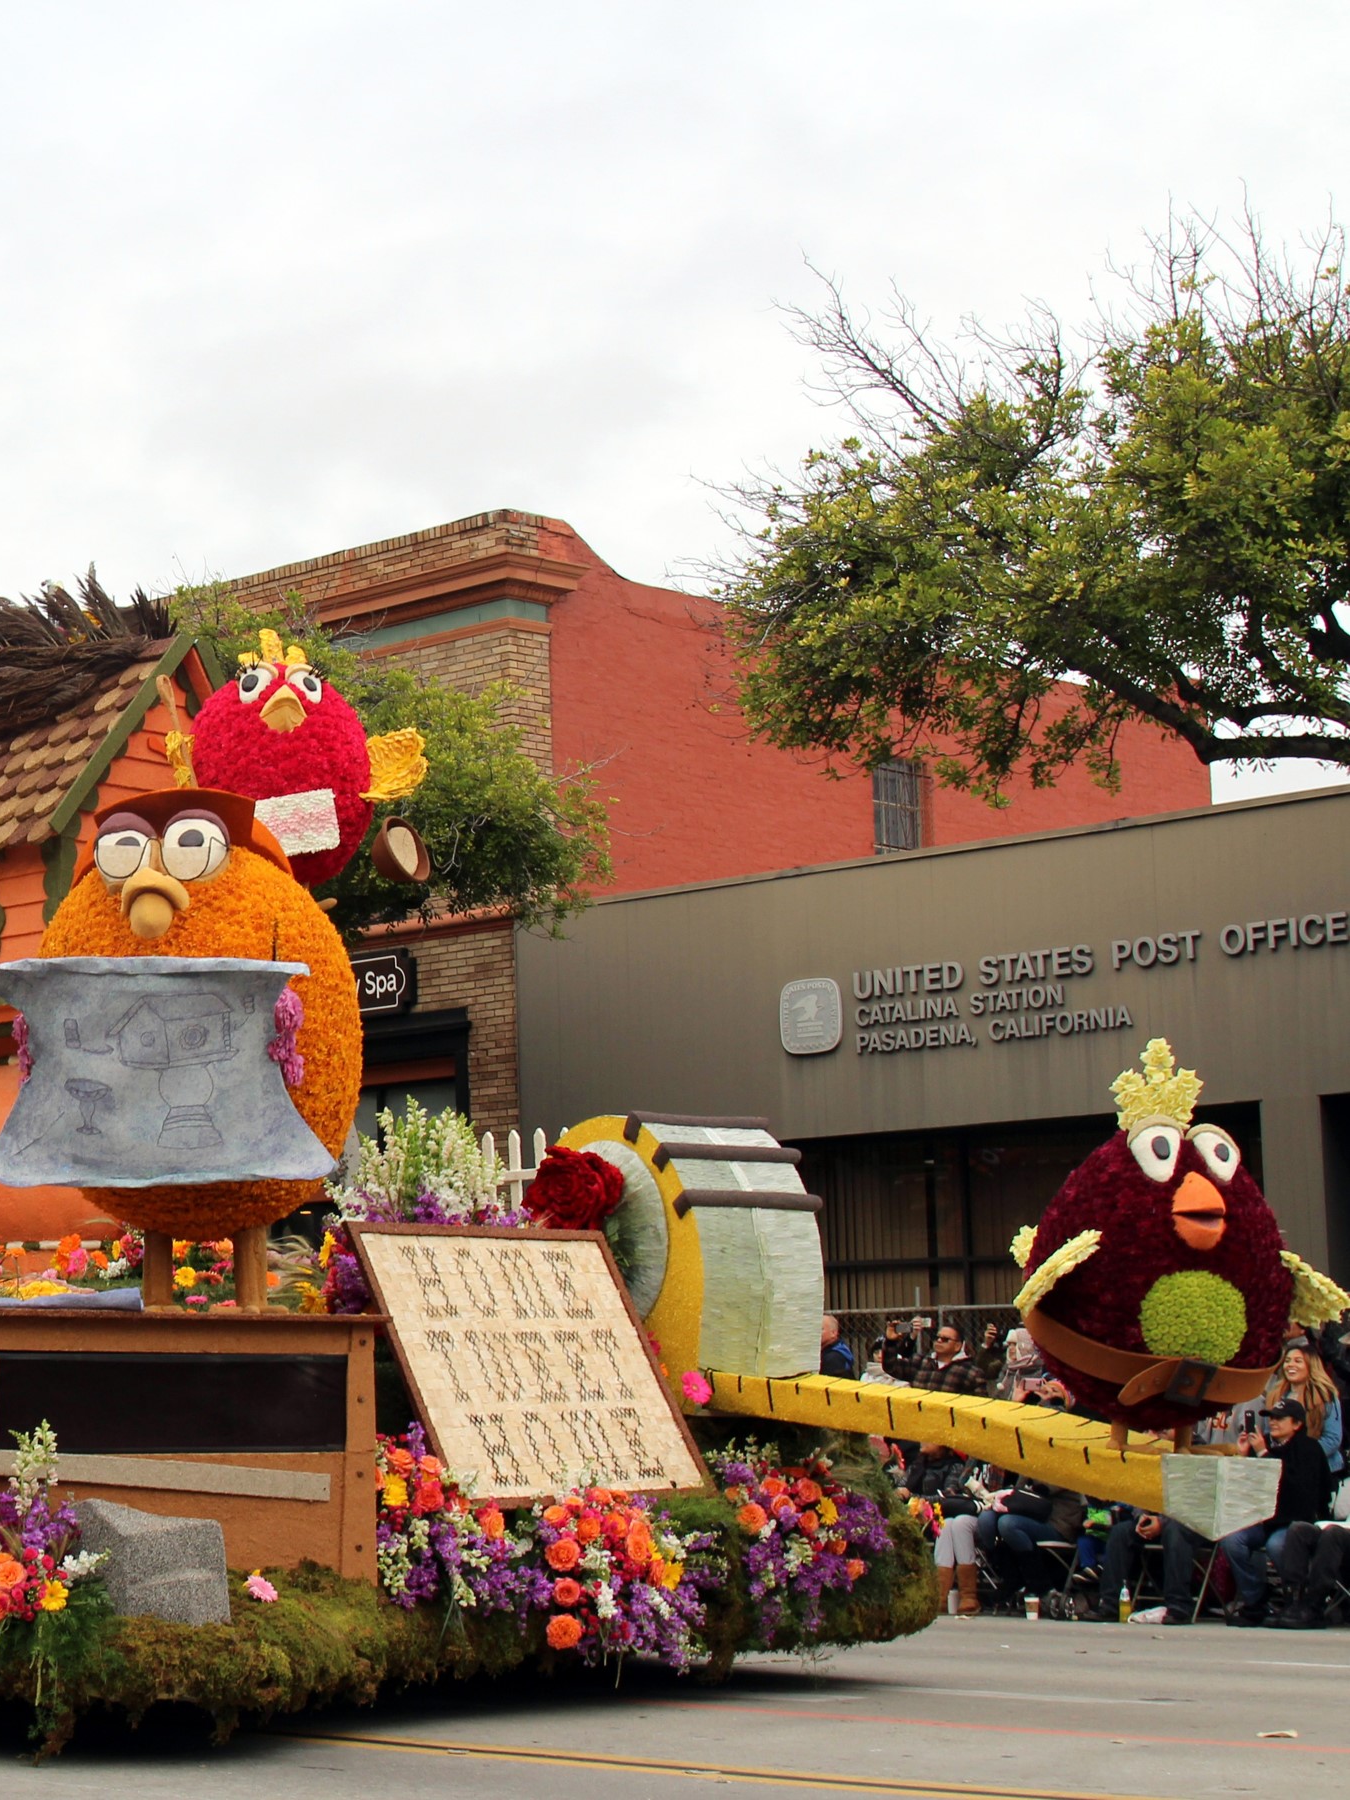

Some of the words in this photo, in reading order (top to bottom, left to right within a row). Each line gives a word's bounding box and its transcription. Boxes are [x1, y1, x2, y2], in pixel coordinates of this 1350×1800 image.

[365, 971, 397, 999] Spa
[853, 961, 964, 1000] UNITED
[979, 944, 1094, 986] STATES
[1111, 929, 1201, 970] POST
[1219, 911, 1349, 956] OFFICE
[855, 997, 960, 1027] CATALINA
[969, 984, 1065, 1016] STATION
[856, 1023, 978, 1054] PASADENA,
[988, 1005, 1132, 1042] CALIFORNIA
[398, 1246, 595, 1319] HOME
[424, 1329, 635, 1403] TWEET
[465, 1407, 666, 1487] HOME
